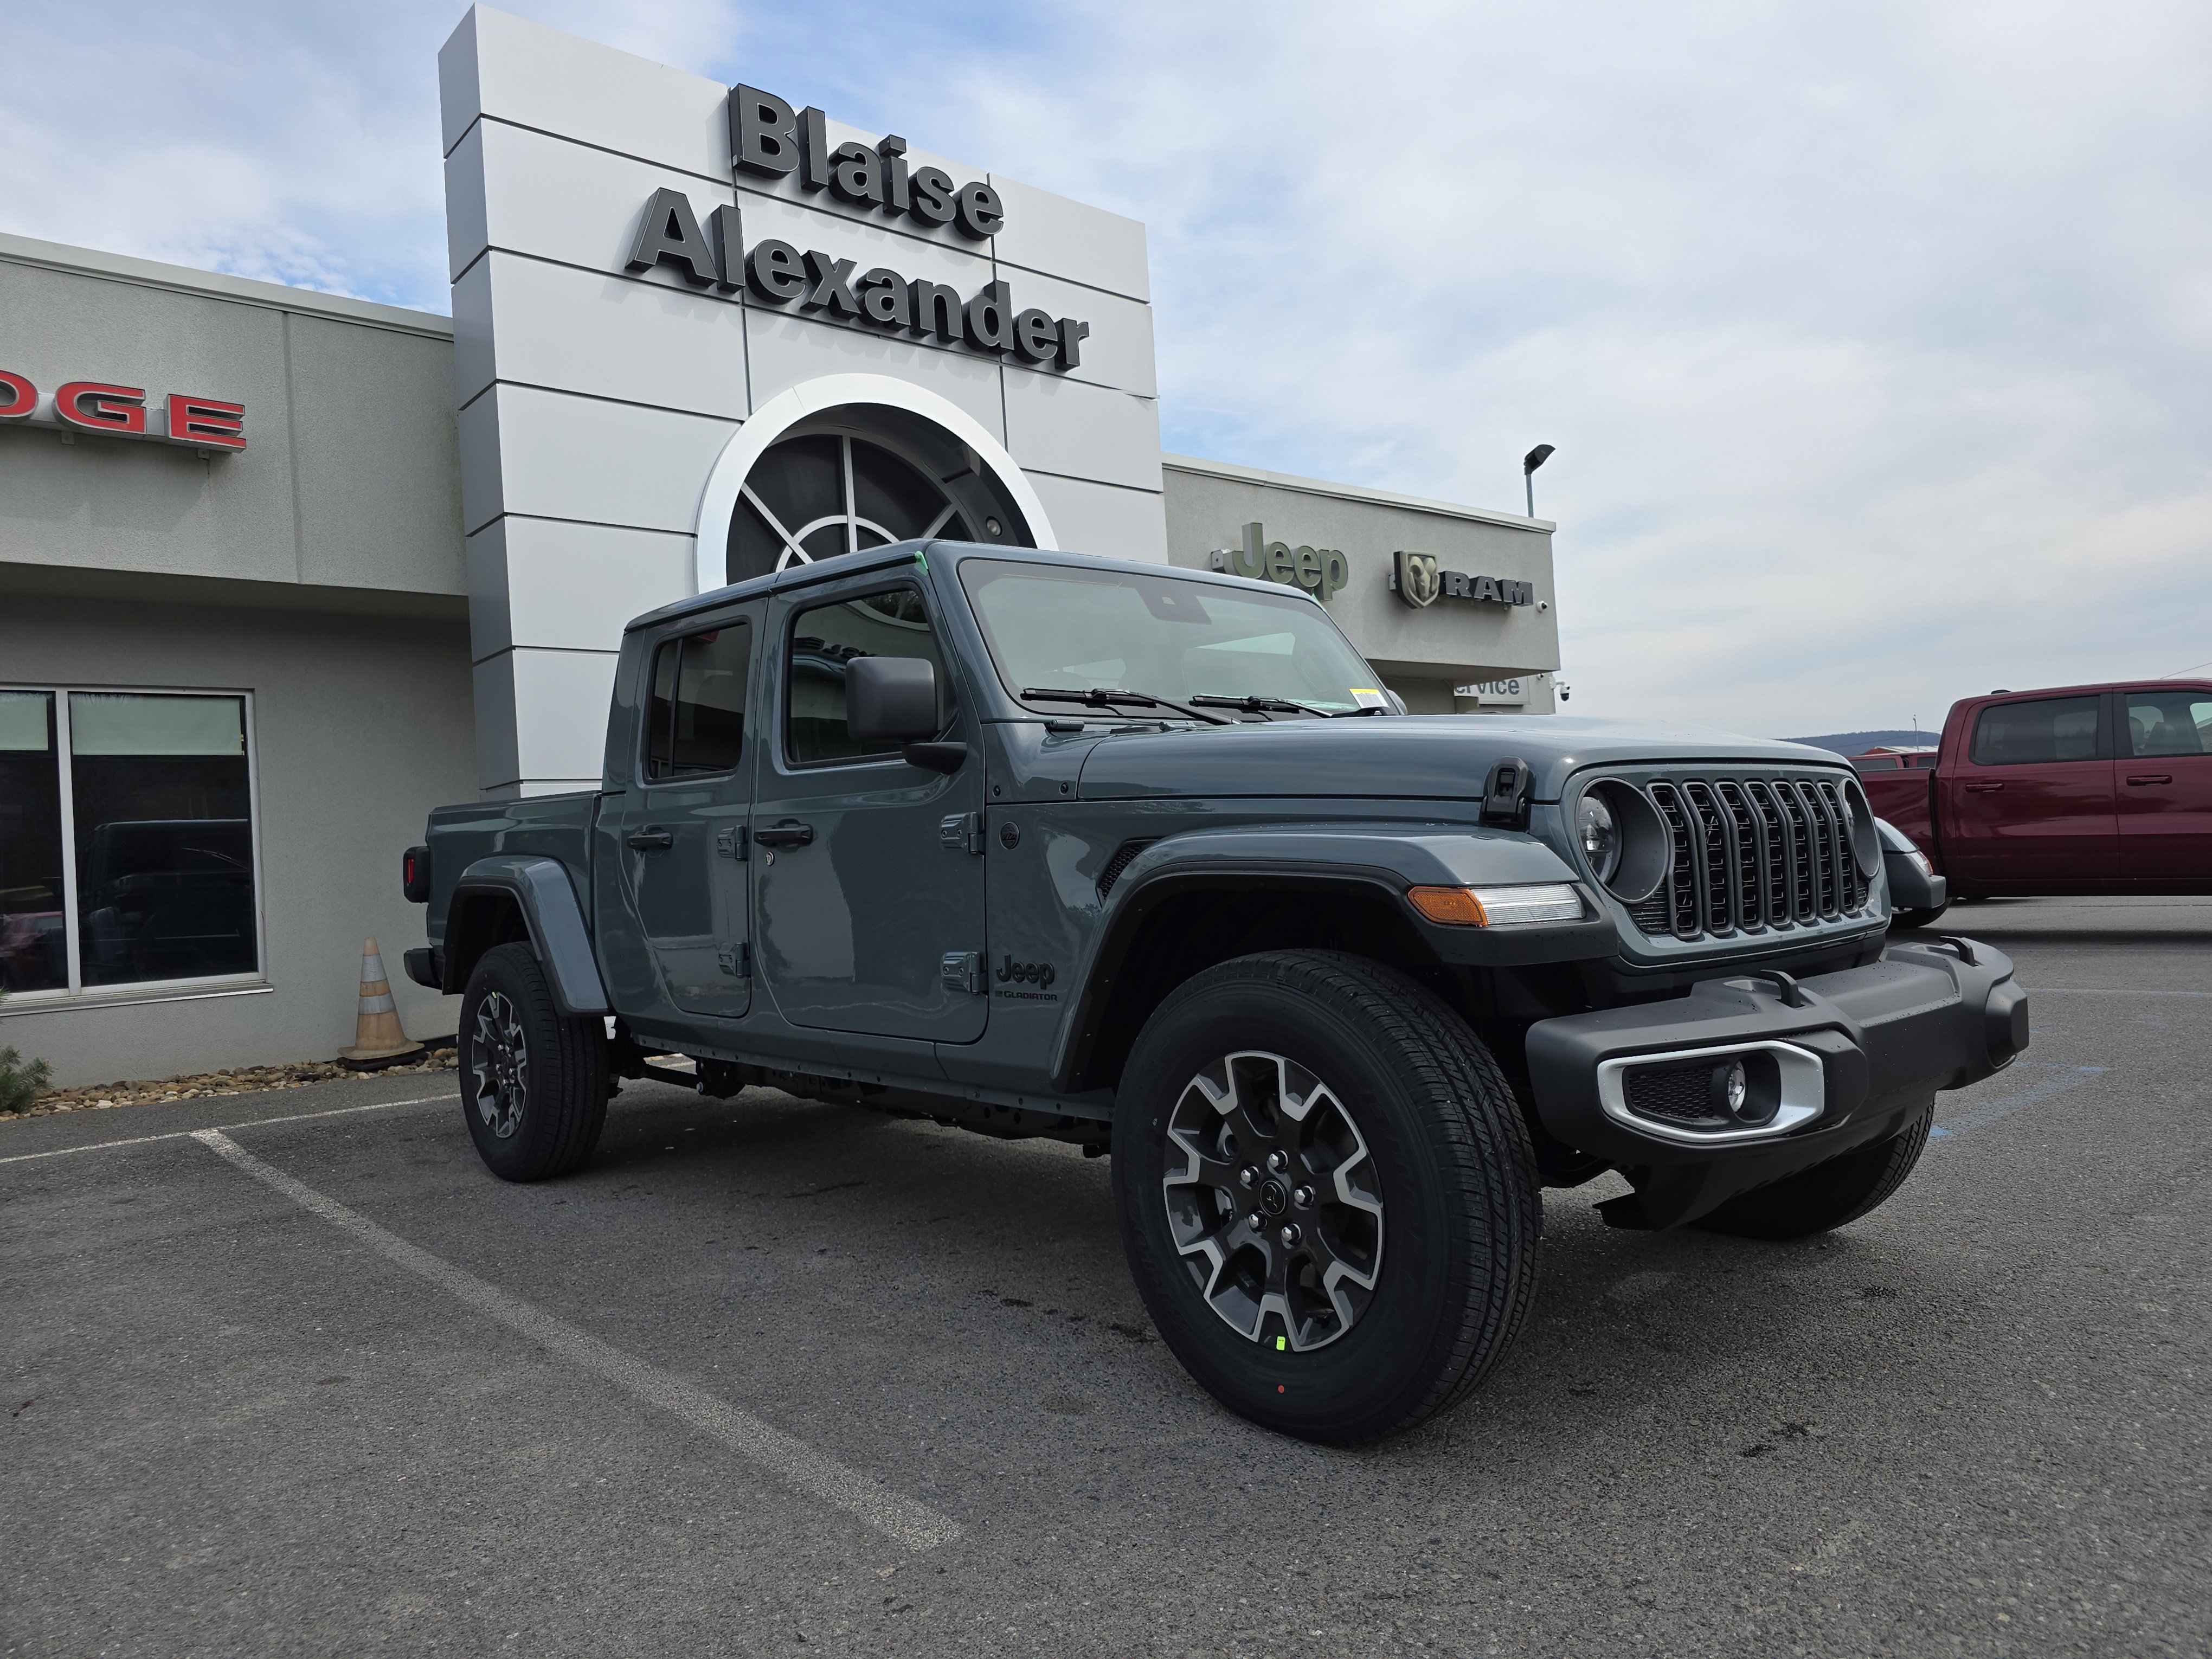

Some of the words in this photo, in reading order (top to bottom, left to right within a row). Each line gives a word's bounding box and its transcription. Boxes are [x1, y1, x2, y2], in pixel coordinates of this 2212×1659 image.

[729, 83, 1004, 241] Blaise
[624, 187, 1089, 371] Alexander
[1223, 522, 1348, 601] Jeep
[1439, 571, 1534, 606] RAM
[995, 954, 1054, 989] Jeep
[1004, 991, 1058, 1001] GLADIATOR
